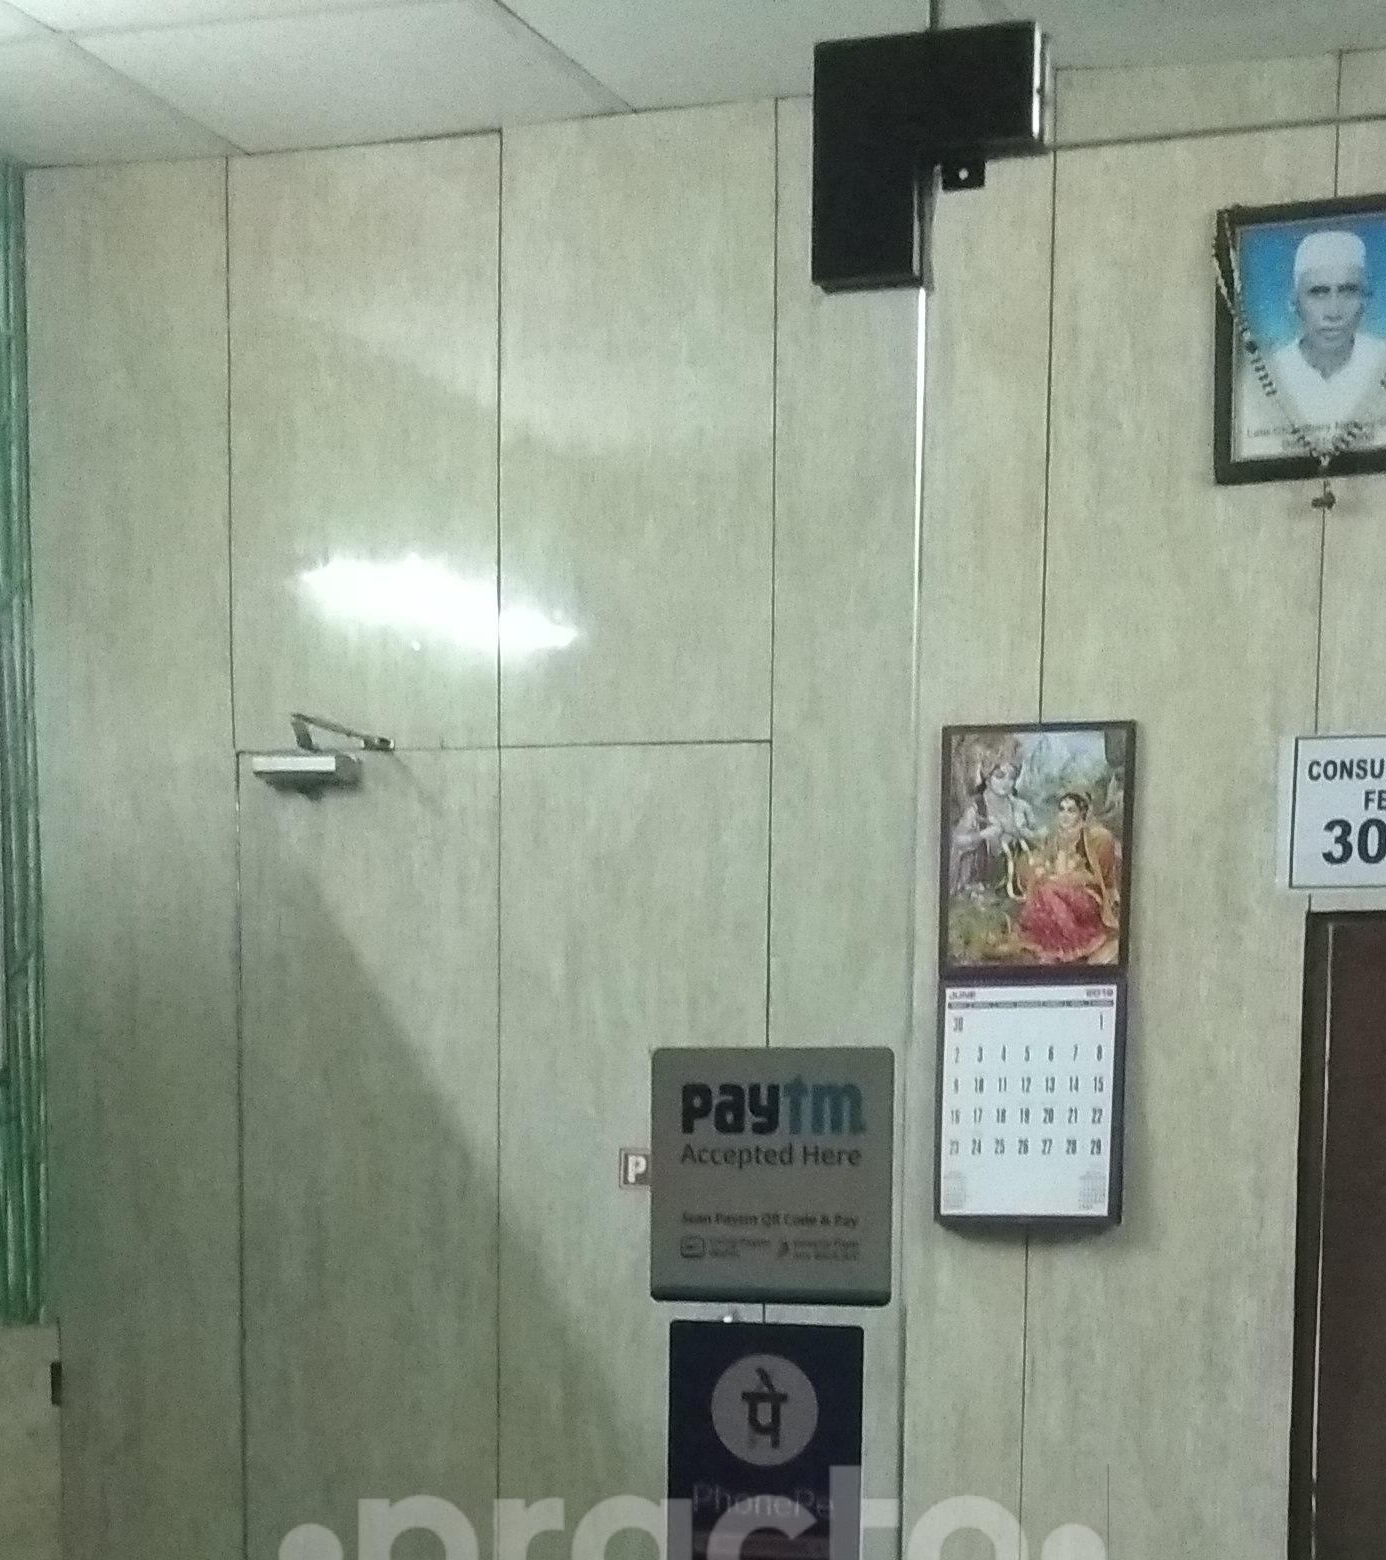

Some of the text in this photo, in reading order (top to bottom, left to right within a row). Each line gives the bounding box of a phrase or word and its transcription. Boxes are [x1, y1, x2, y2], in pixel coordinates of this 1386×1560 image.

[954, 1017, 963, 1032] 30
[978, 1046, 983, 1063] 3
[1024, 1046, 1030, 1062] 5
[1049, 1045, 1054, 1062] 6
[1073, 1044, 1078, 1061] 7
[975, 1078, 984, 1093] 10
[999, 1077, 1007, 1092] 11
[1022, 1077, 1031, 1092] 12
[1046, 1077, 1055, 1092] 13
[1069, 1076, 1079, 1092] 14
[1094, 1076, 1103, 1092] 15
[974, 1108, 983, 1124] 17
[997, 1108, 1006, 1123] 18
[1020, 1108, 1029, 1124] 19
[1043, 1108, 1054, 1124] 20
[1068, 1108, 1078, 1124] 21
[1092, 1108, 1103, 1124] 22
[972, 1139, 981, 1155] 24
[995, 1139, 1005, 1154] 25
[1018, 1139, 1029, 1154] 26
[1042, 1139, 1053, 1155] 27
[1066, 1139, 1077, 1155] 28
[1091, 1139, 1101, 1155] 29
[680, 1142, 863, 1170] Accepted Here
